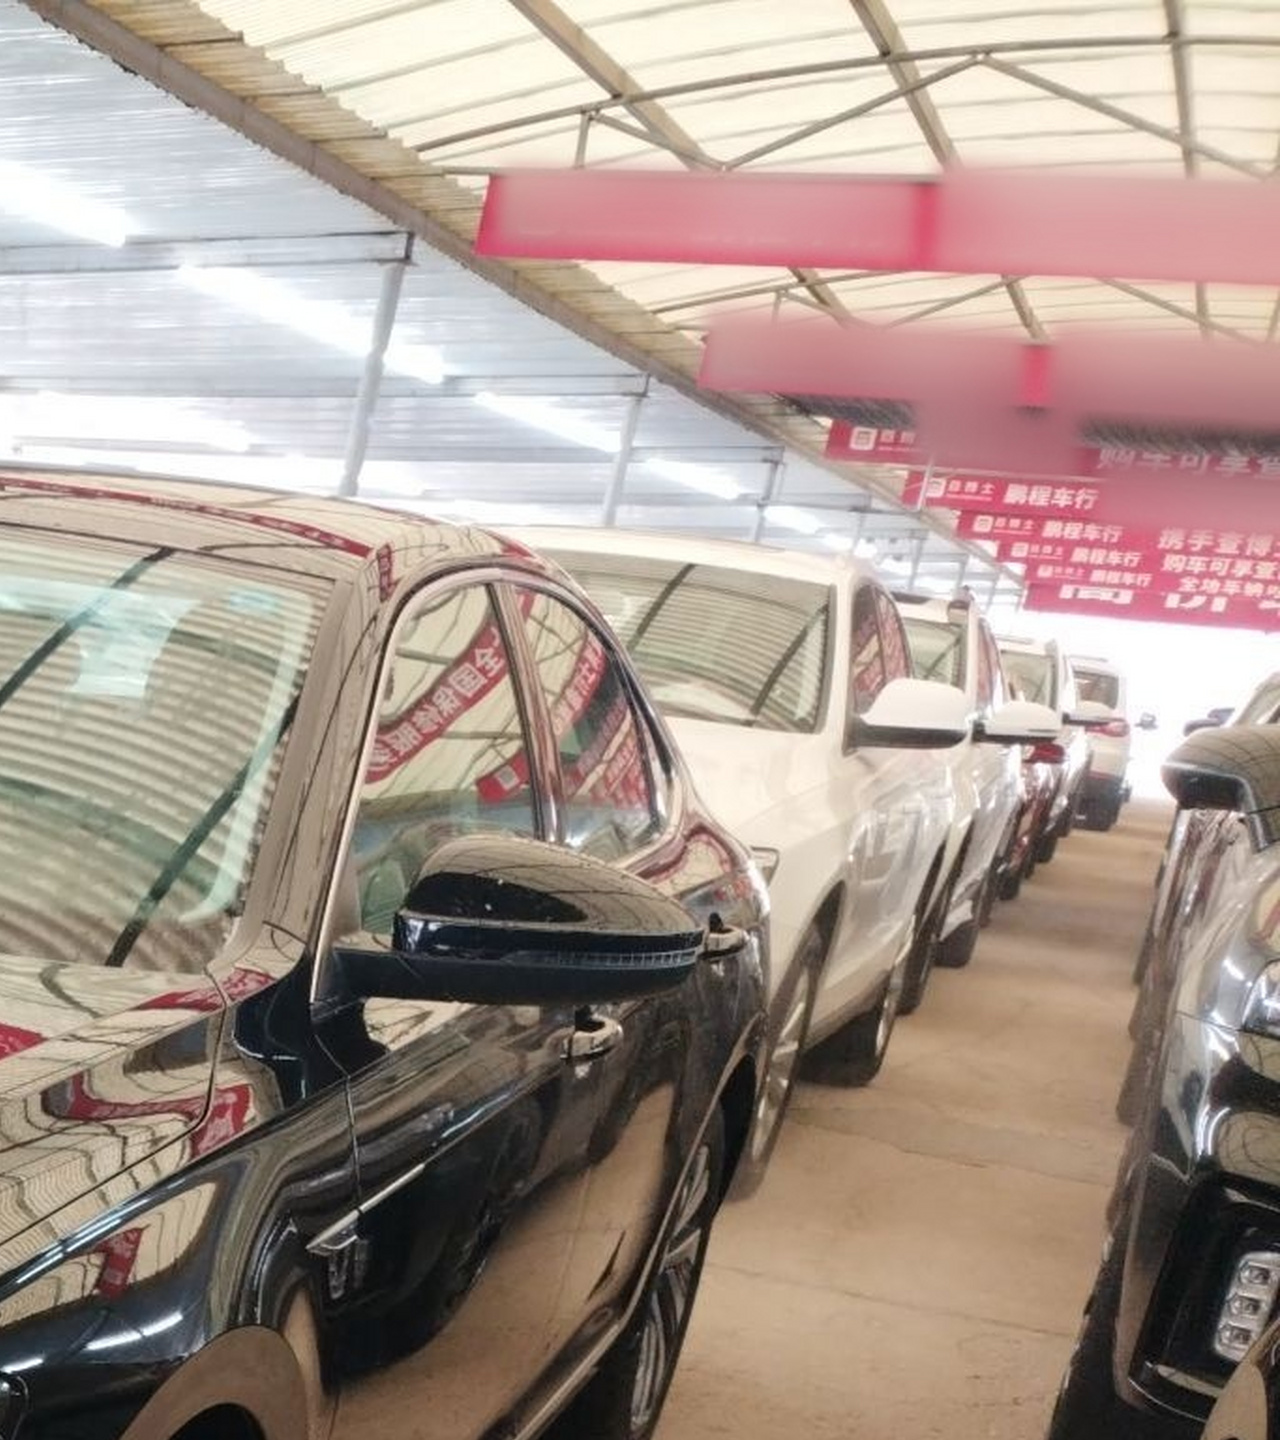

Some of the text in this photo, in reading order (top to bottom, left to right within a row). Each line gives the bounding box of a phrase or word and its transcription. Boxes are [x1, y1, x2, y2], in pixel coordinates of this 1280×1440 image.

[1157, 529, 1280, 557] 携手查博
[1161, 554, 1280, 579] 购车可享查
